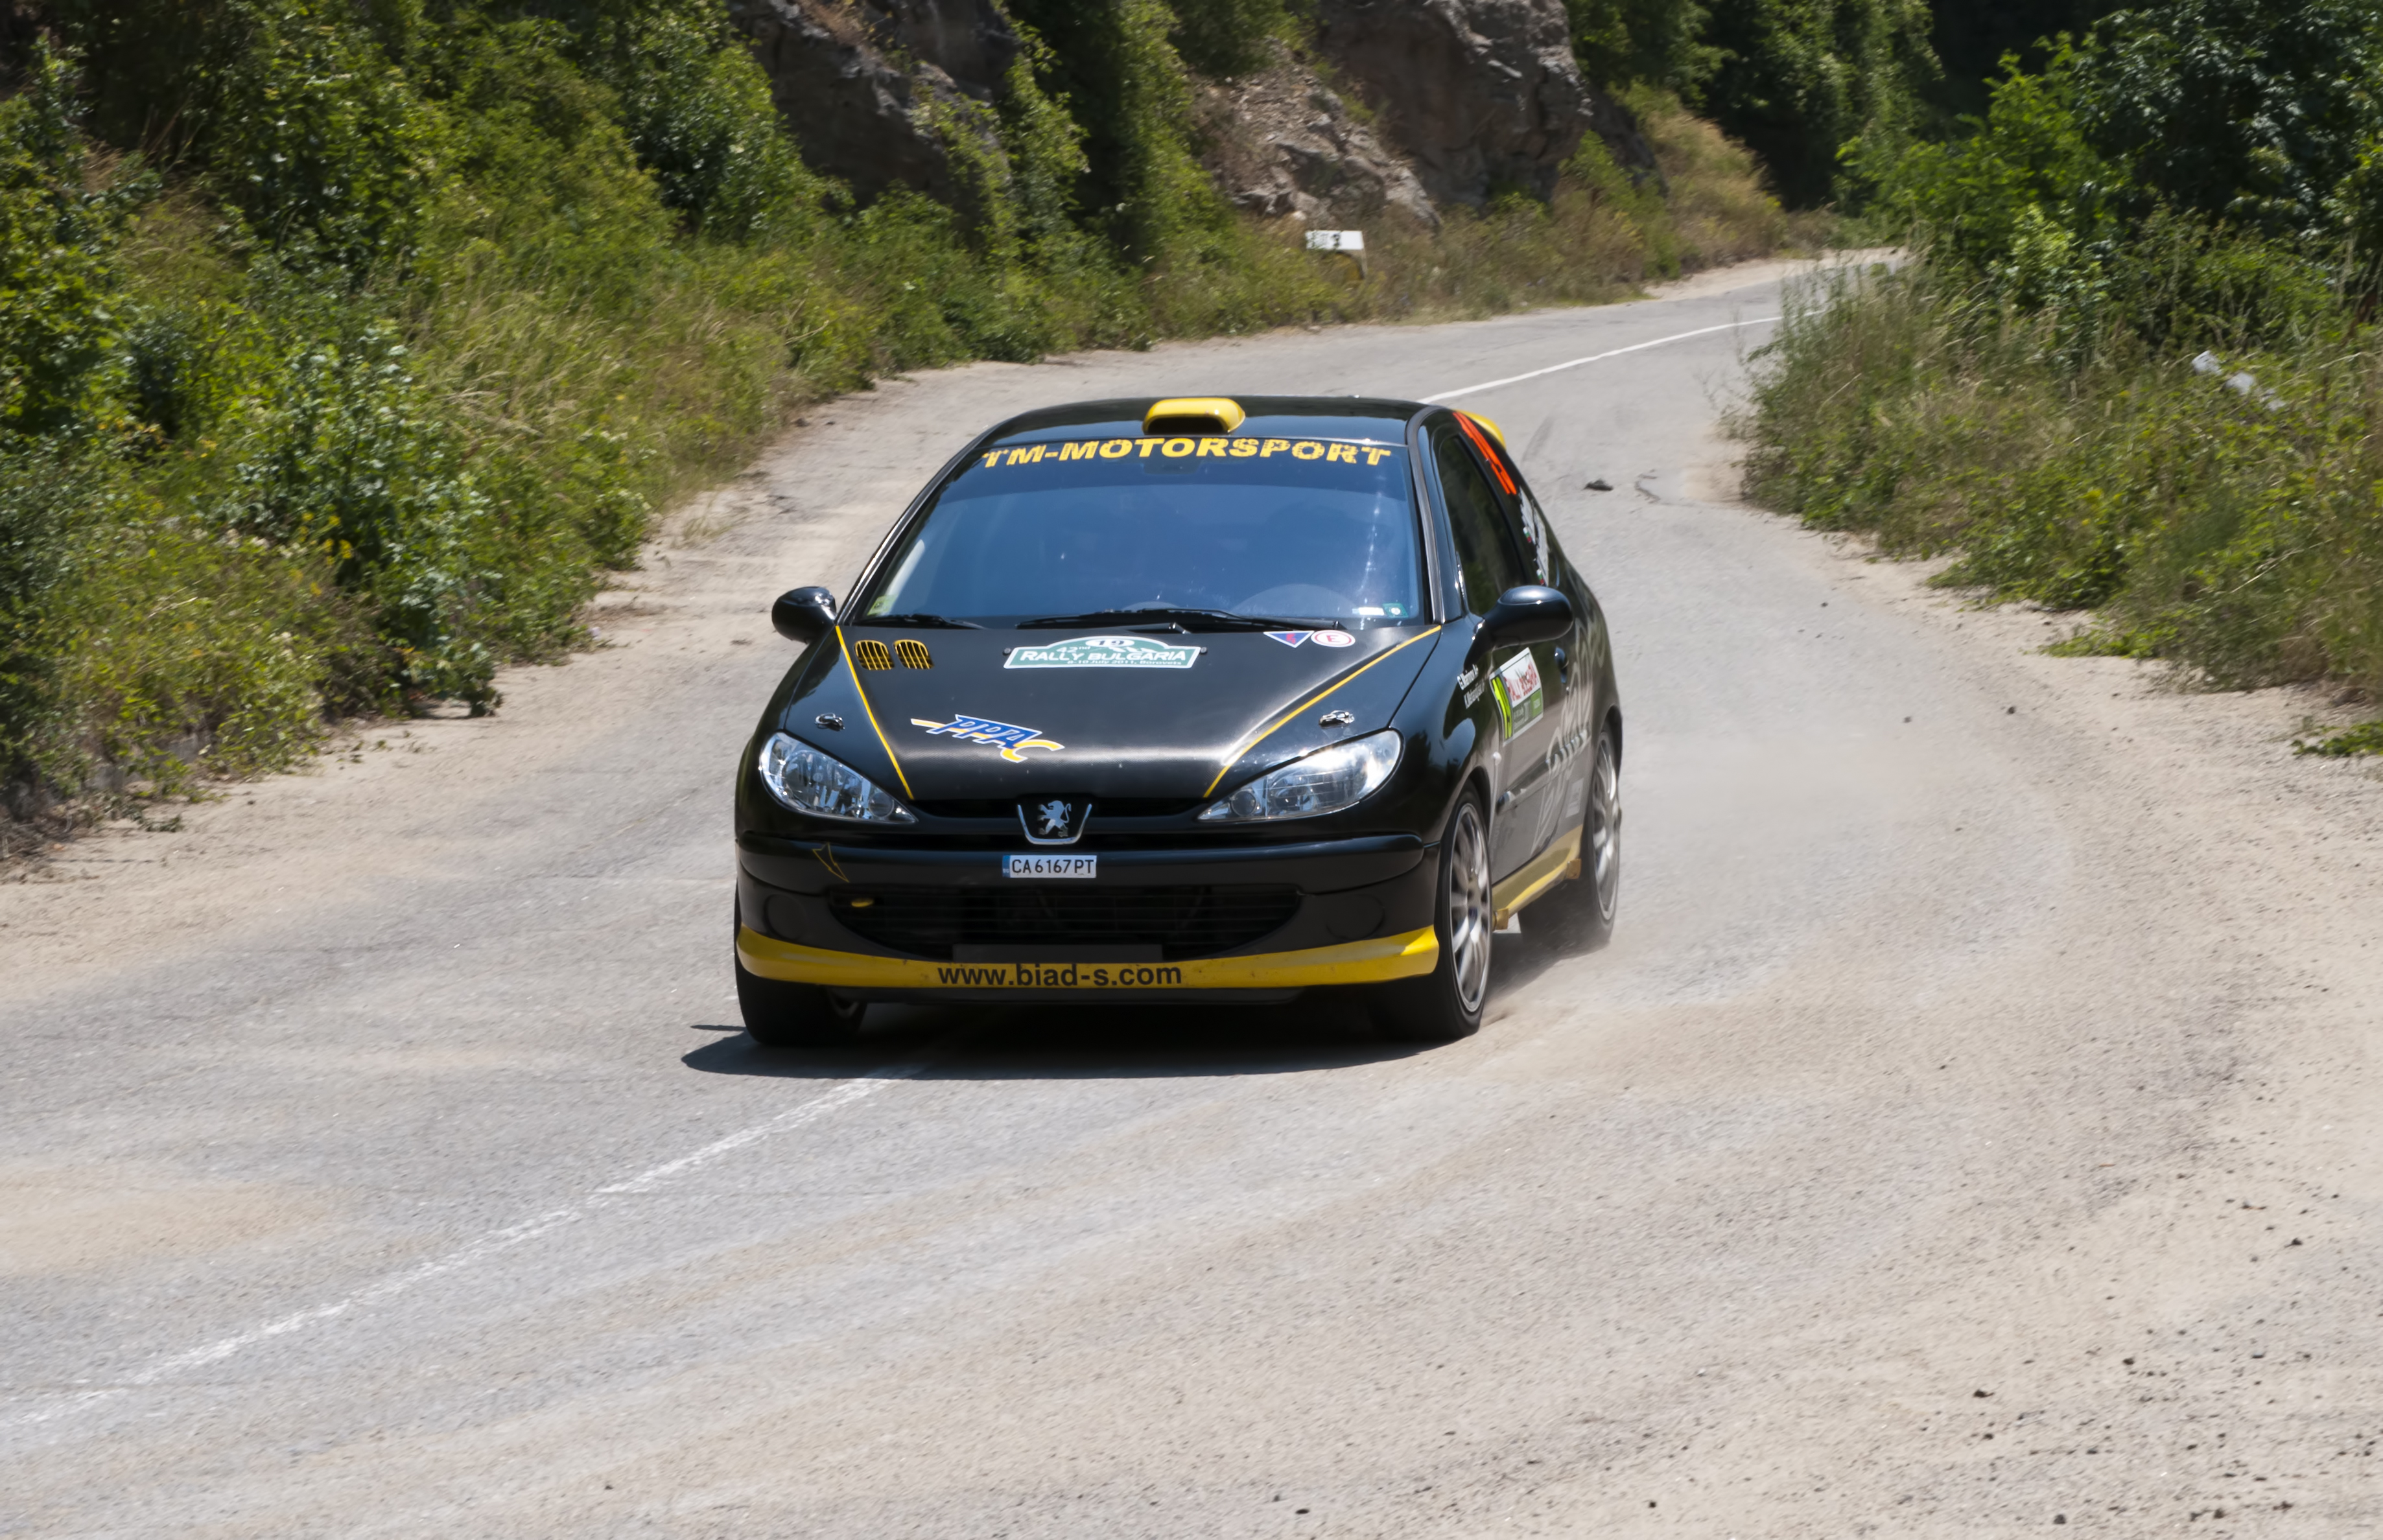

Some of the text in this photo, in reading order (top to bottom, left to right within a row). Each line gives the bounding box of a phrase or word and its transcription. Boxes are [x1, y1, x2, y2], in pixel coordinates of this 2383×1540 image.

[982, 437, 1391, 468] TM-MOTORSPORT
[1020, 650, 1186, 661] RALLY BULGARIA
[937, 963, 1181, 986] www.biad-s.com
